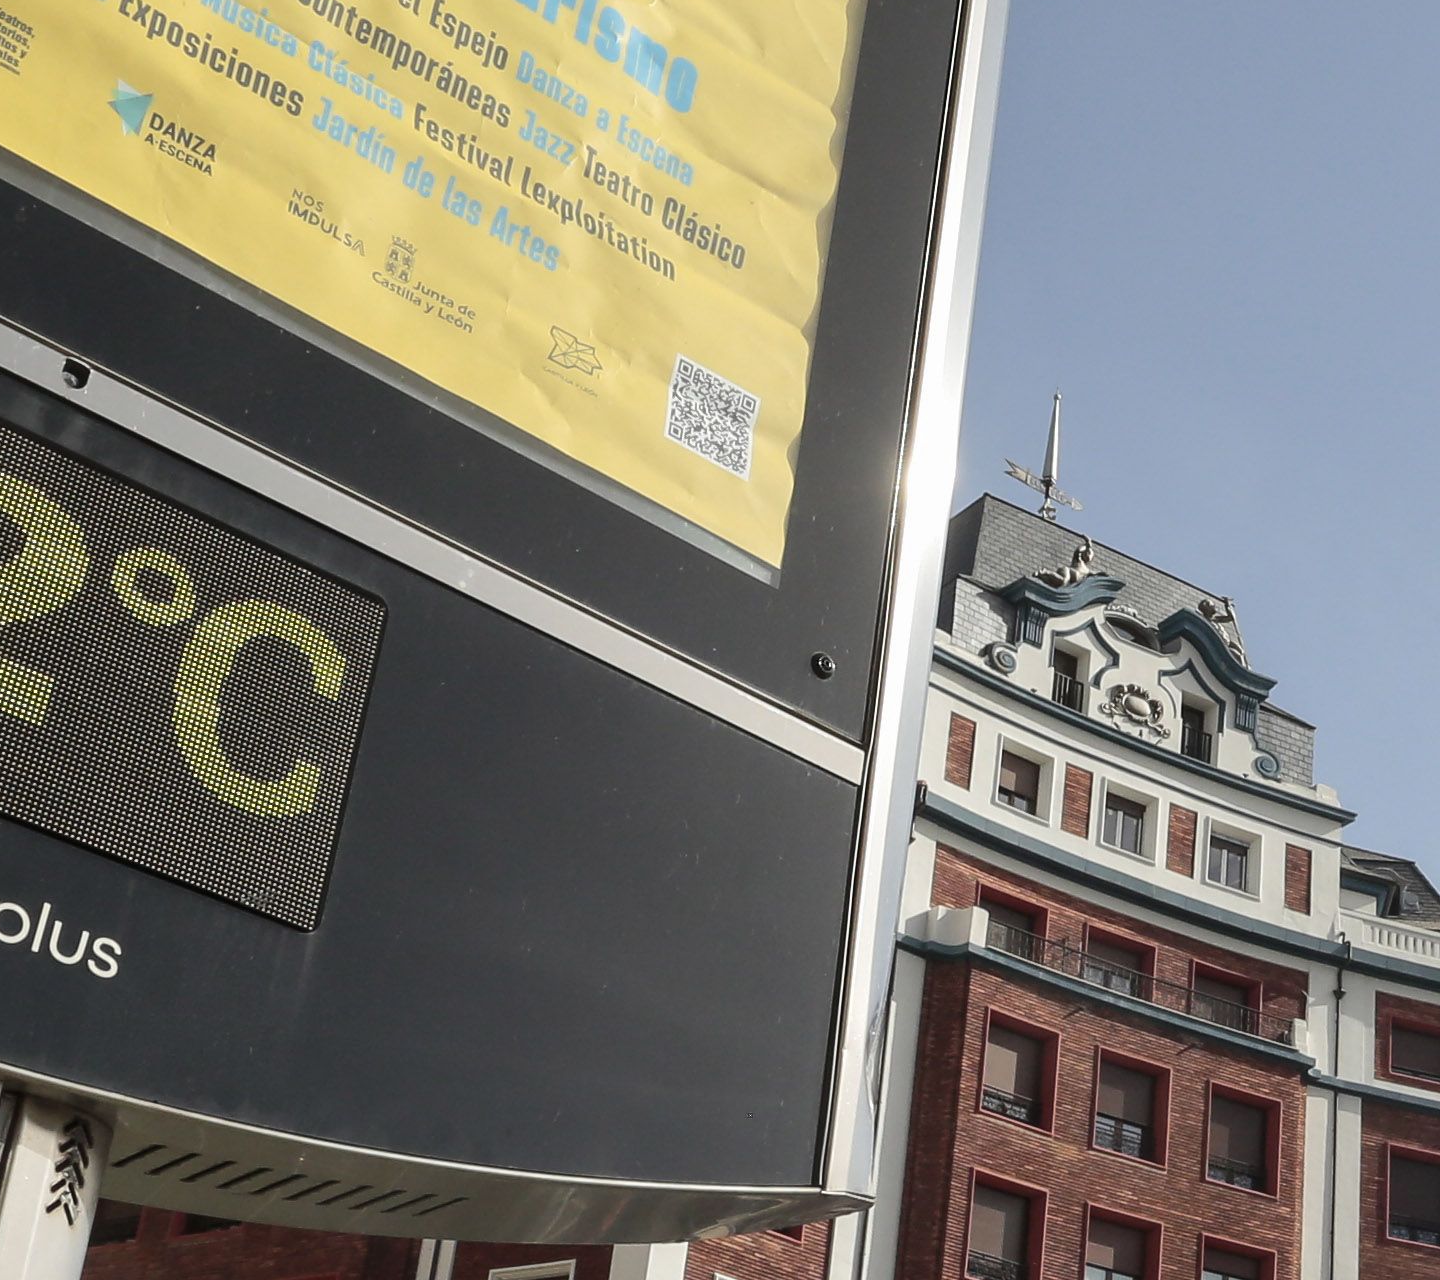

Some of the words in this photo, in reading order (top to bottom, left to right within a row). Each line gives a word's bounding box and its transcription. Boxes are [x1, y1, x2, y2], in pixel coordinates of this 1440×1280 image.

[19, 47, 28, 59] y
[148, 112, 217, 163] DANZA
[515, 50, 590, 117] Danza
[596, 108, 612, 133] a
[615, 114, 695, 187] Escena
[292, 188, 325, 213] NOS
[312, 97, 398, 174] Jardín
[402, 156, 436, 198] de
[442, 175, 484, 226] las
[489, 205, 561, 272] Artes
[414, 102, 514, 187] Festival
[520, 165, 675, 282] Lexploitation
[519, 109, 577, 166] Jazz
[582, 145, 654, 217] Teatro
[661, 196, 746, 270] Clásico
[371, 270, 423, 307] Castilla
[423, 299, 435, 315] y
[437, 306, 474, 334] León
[412, 280, 455, 310] Junta
[456, 304, 477, 320] de
